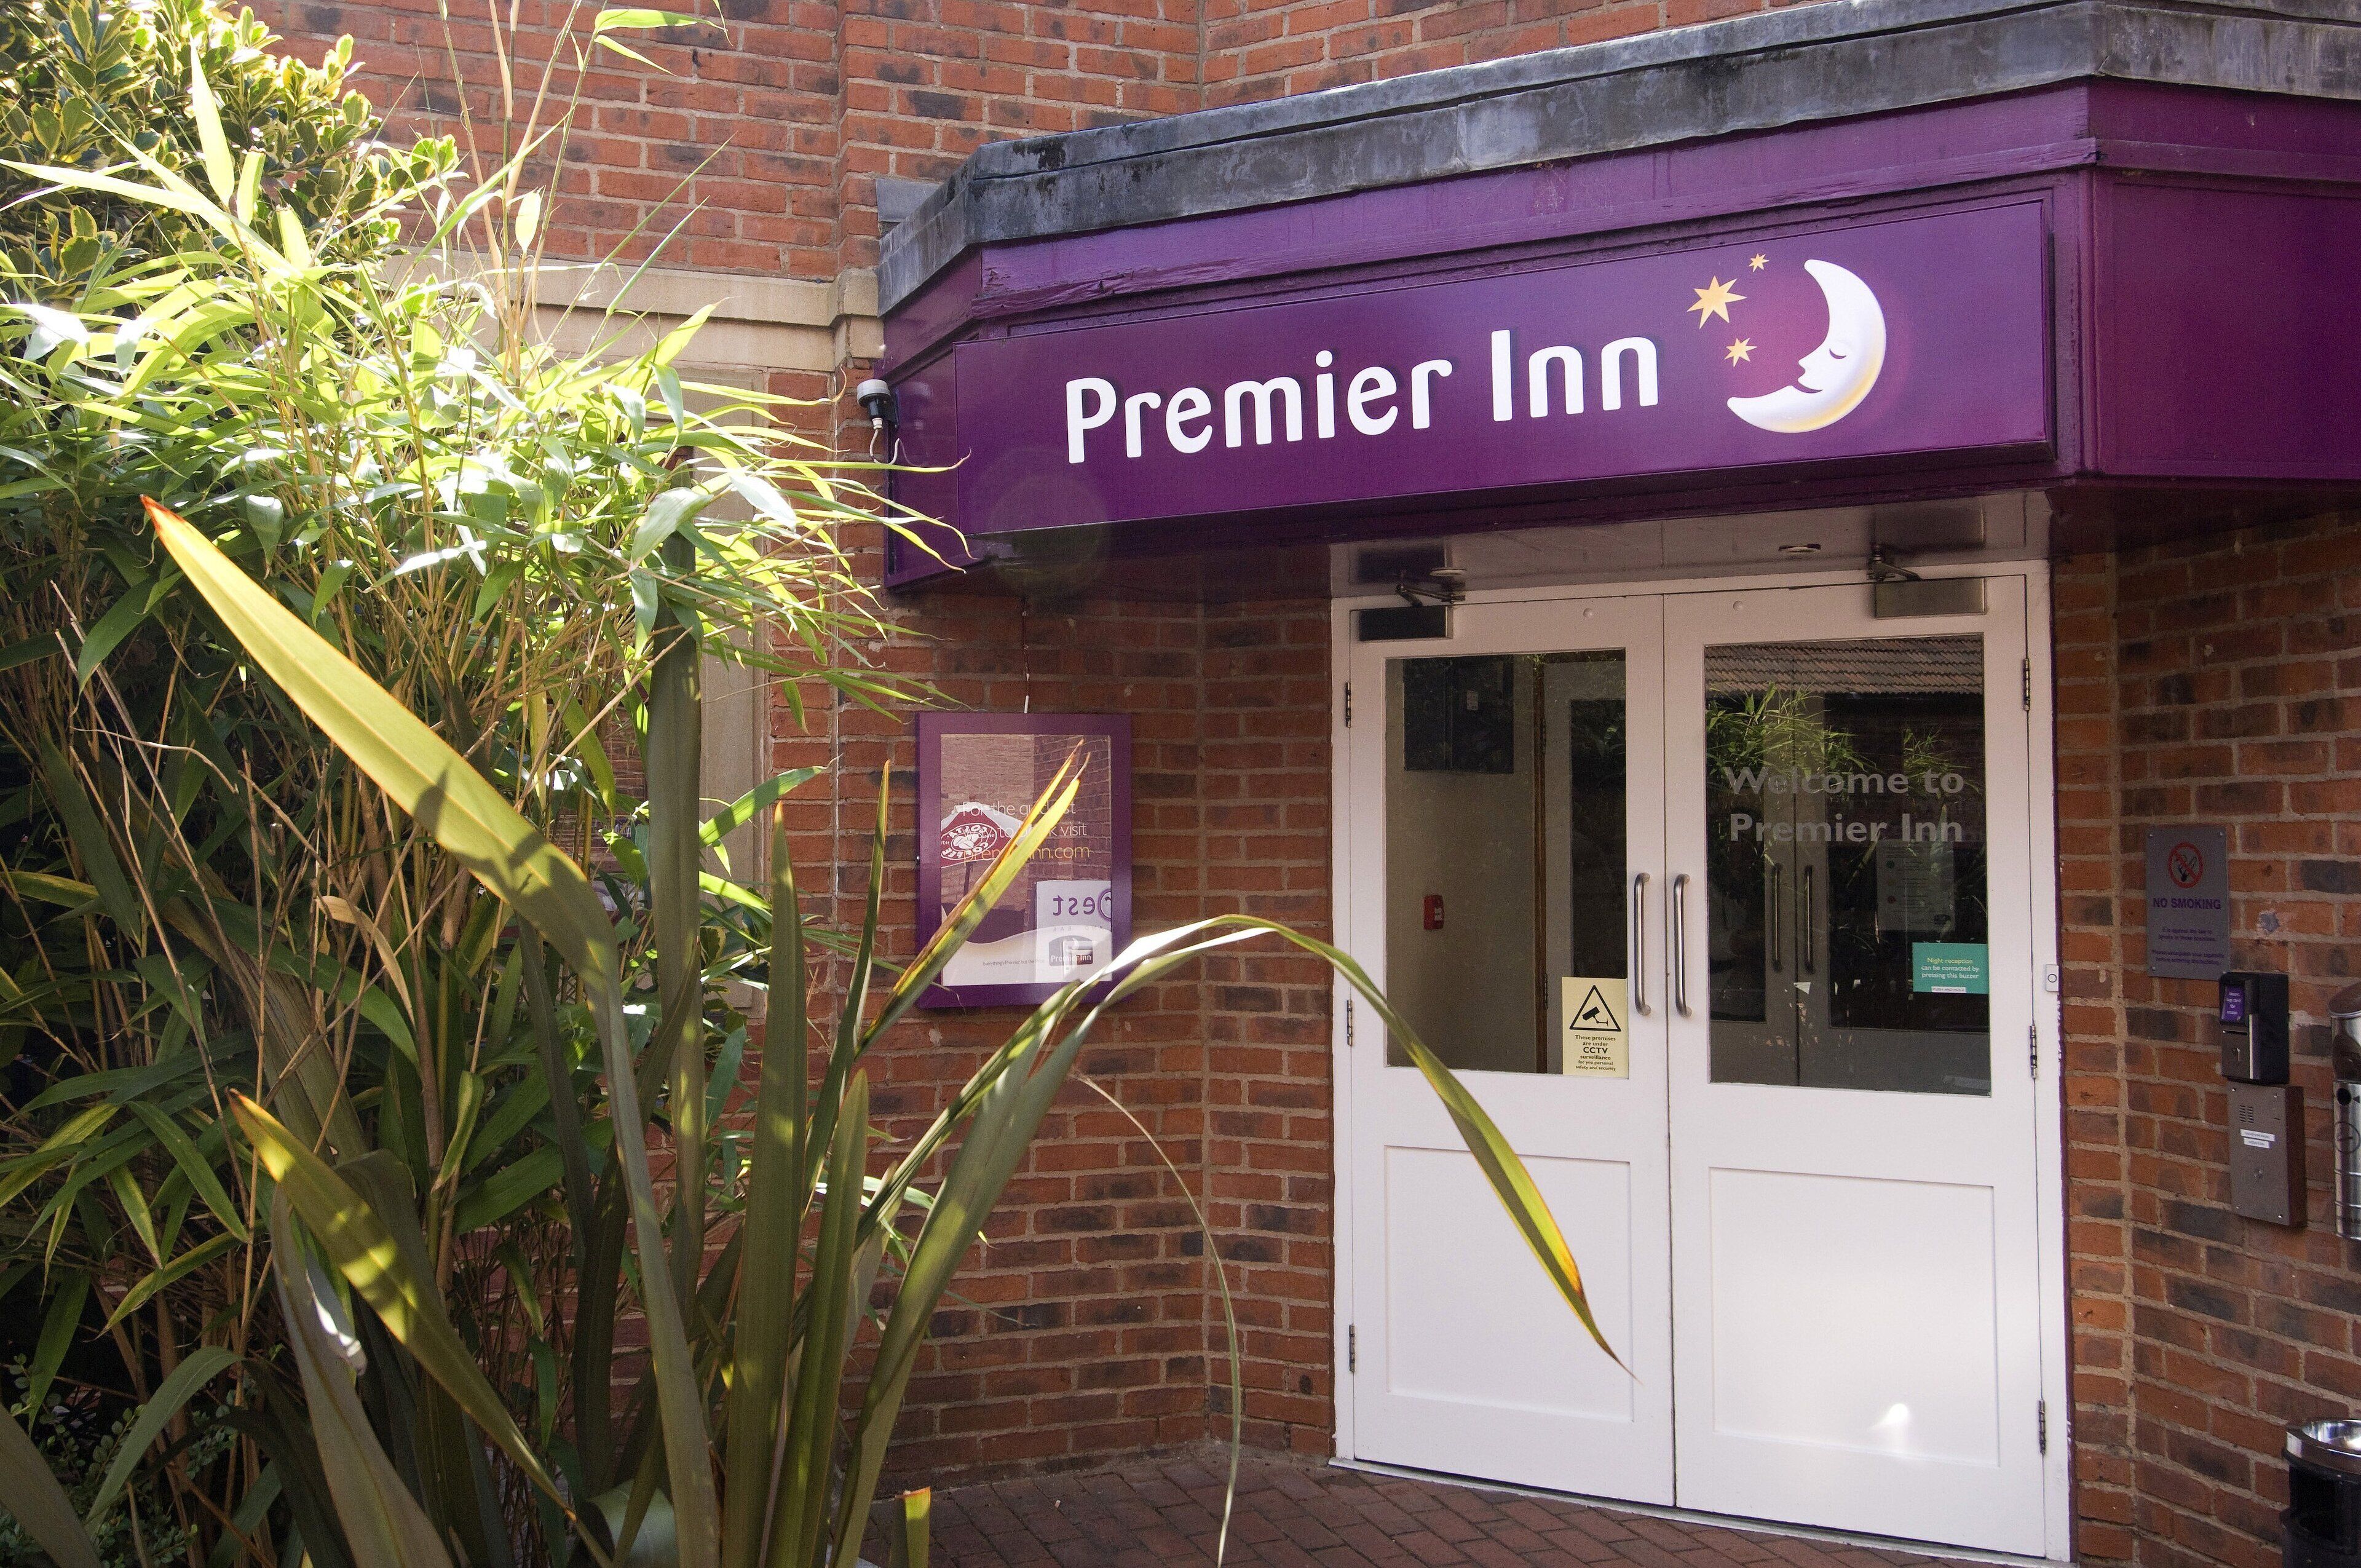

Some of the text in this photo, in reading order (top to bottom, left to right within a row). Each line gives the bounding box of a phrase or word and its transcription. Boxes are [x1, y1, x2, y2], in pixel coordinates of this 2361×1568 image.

[1065, 329, 1659, 464] Premier Inn
[1724, 766, 1964, 794] Welcome to
[962, 801, 984, 817] For
[991, 801, 1016, 815] the
[997, 825, 1014, 838] to
[1061, 822, 1088, 837] visit
[1730, 812, 1963, 842] Premier Inn
[2153, 898, 2221, 909] NO SMOKING
